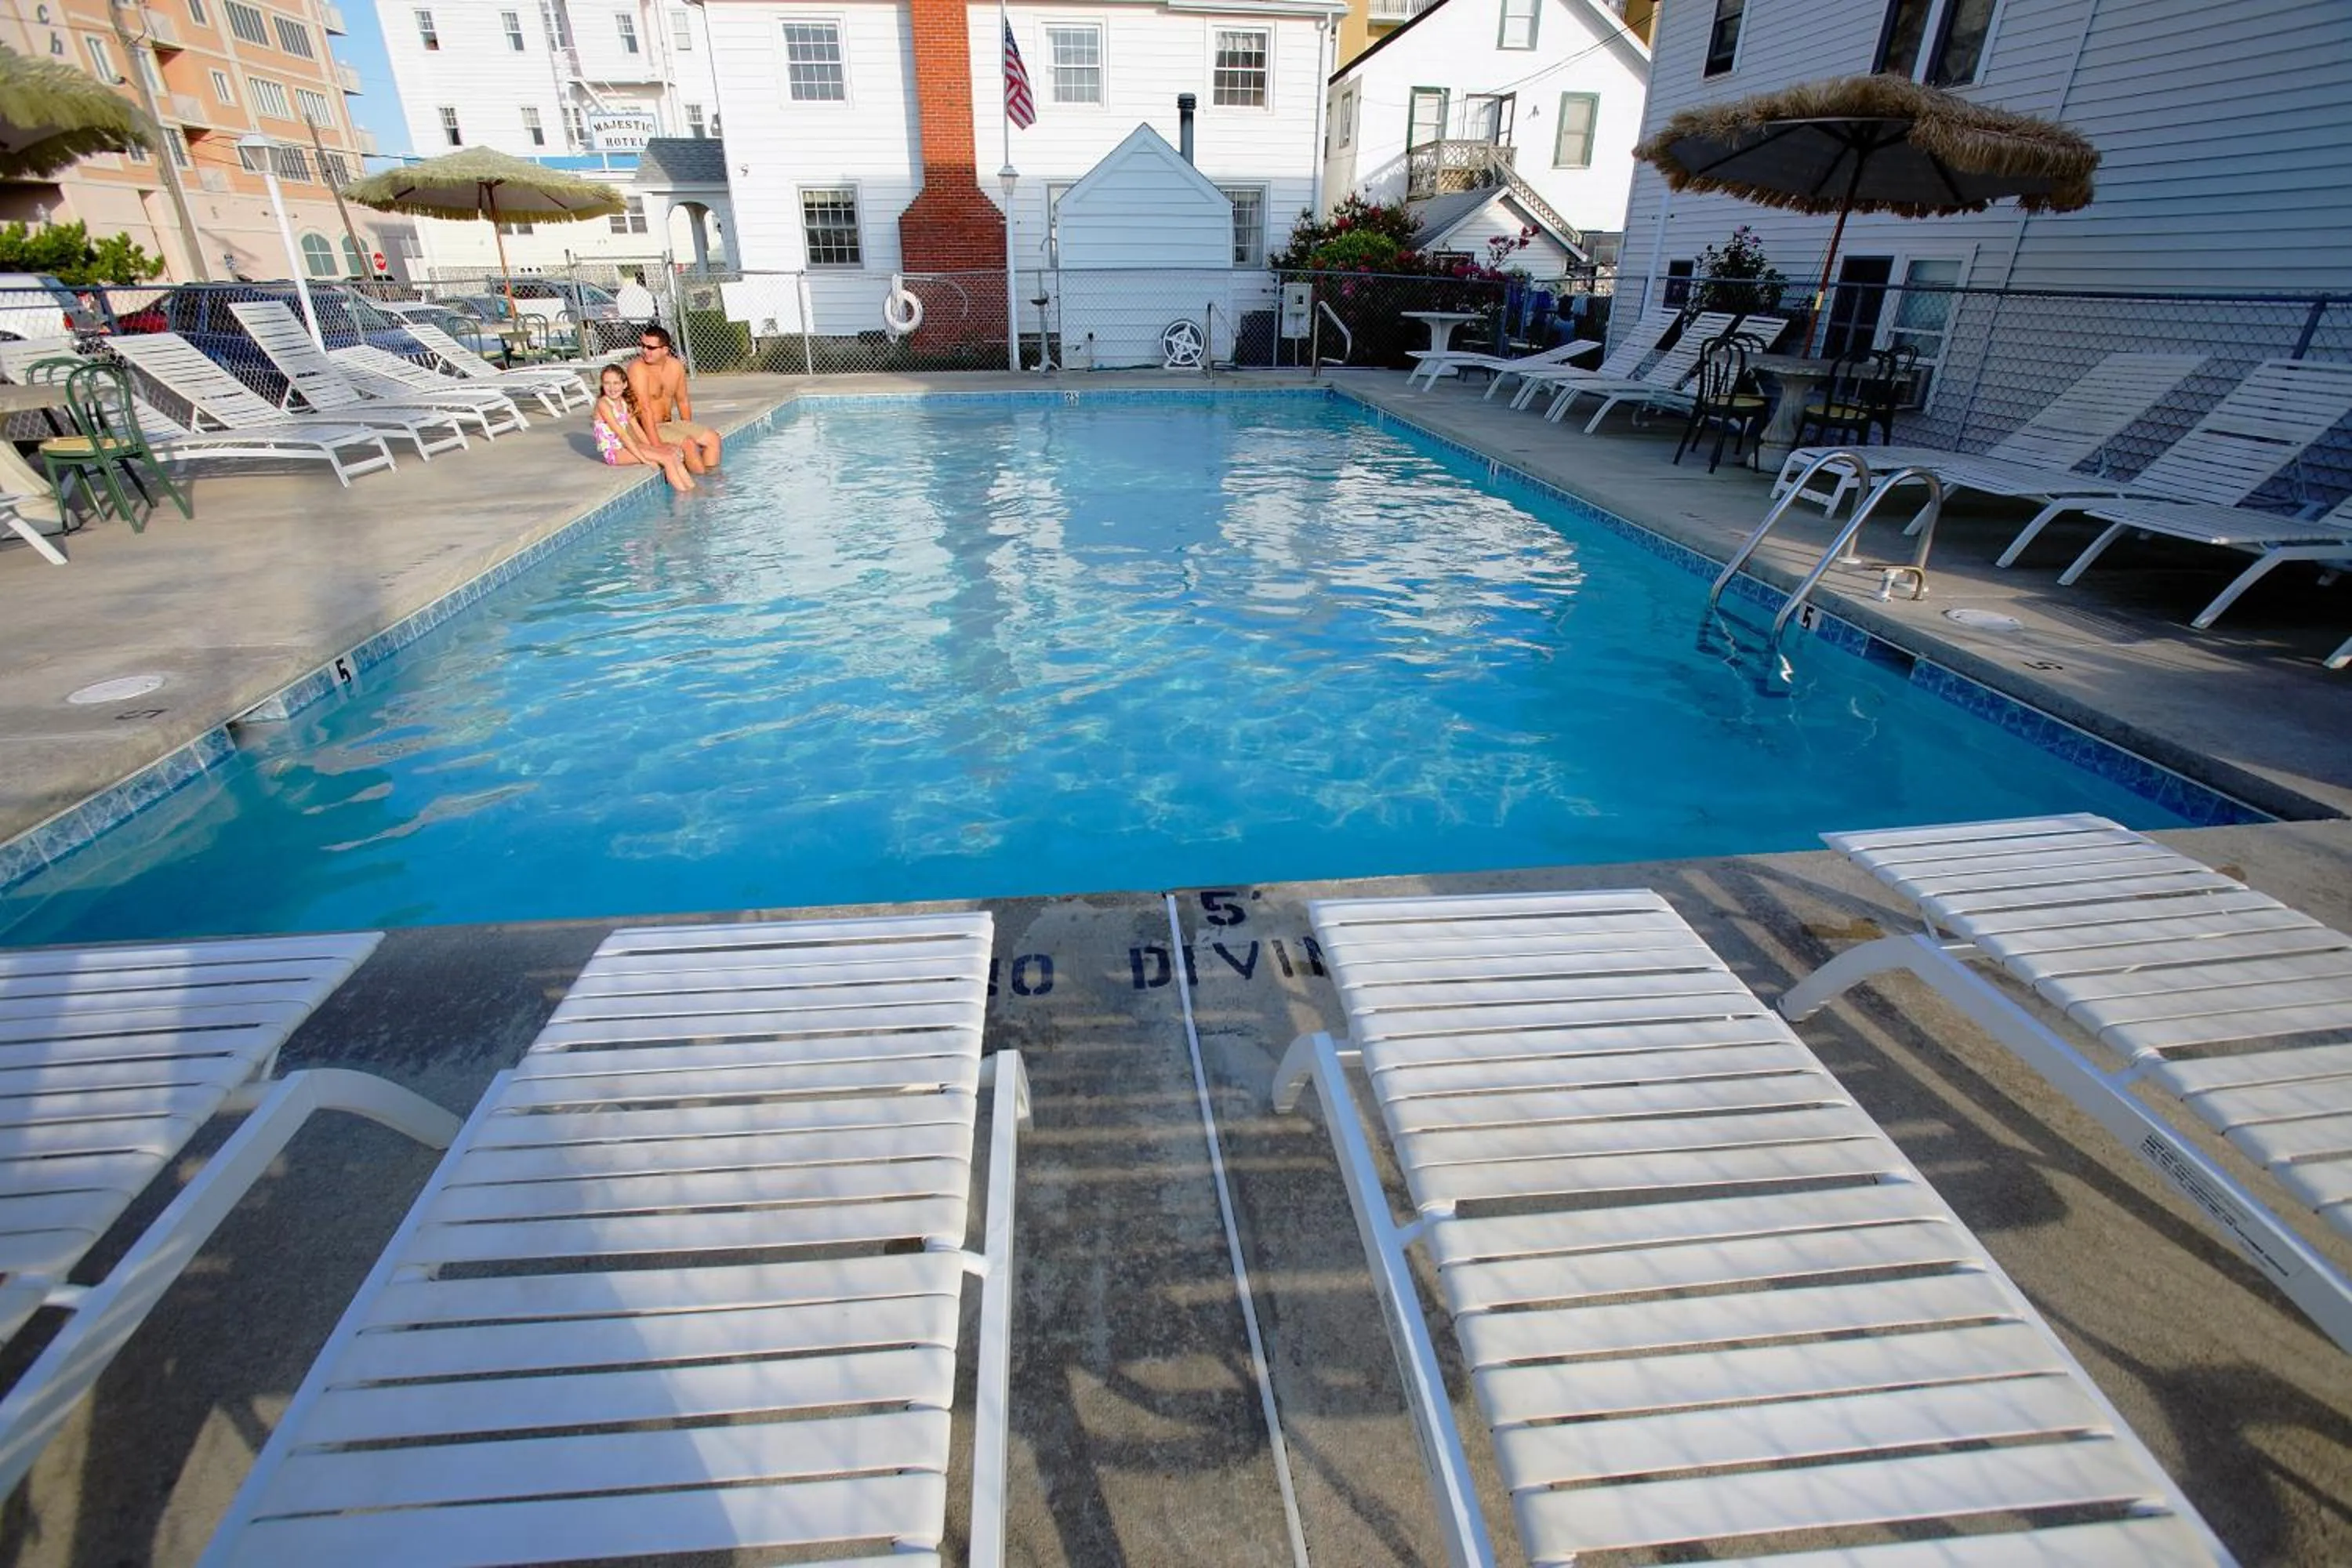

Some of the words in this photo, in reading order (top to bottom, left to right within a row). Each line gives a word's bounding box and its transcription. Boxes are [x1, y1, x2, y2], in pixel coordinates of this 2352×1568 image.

[593, 120, 653, 132] MAJESTIC
[604, 137, 647, 147] HOTEL
[336, 657, 352, 684] 5
[988, 953, 1054, 996] O
